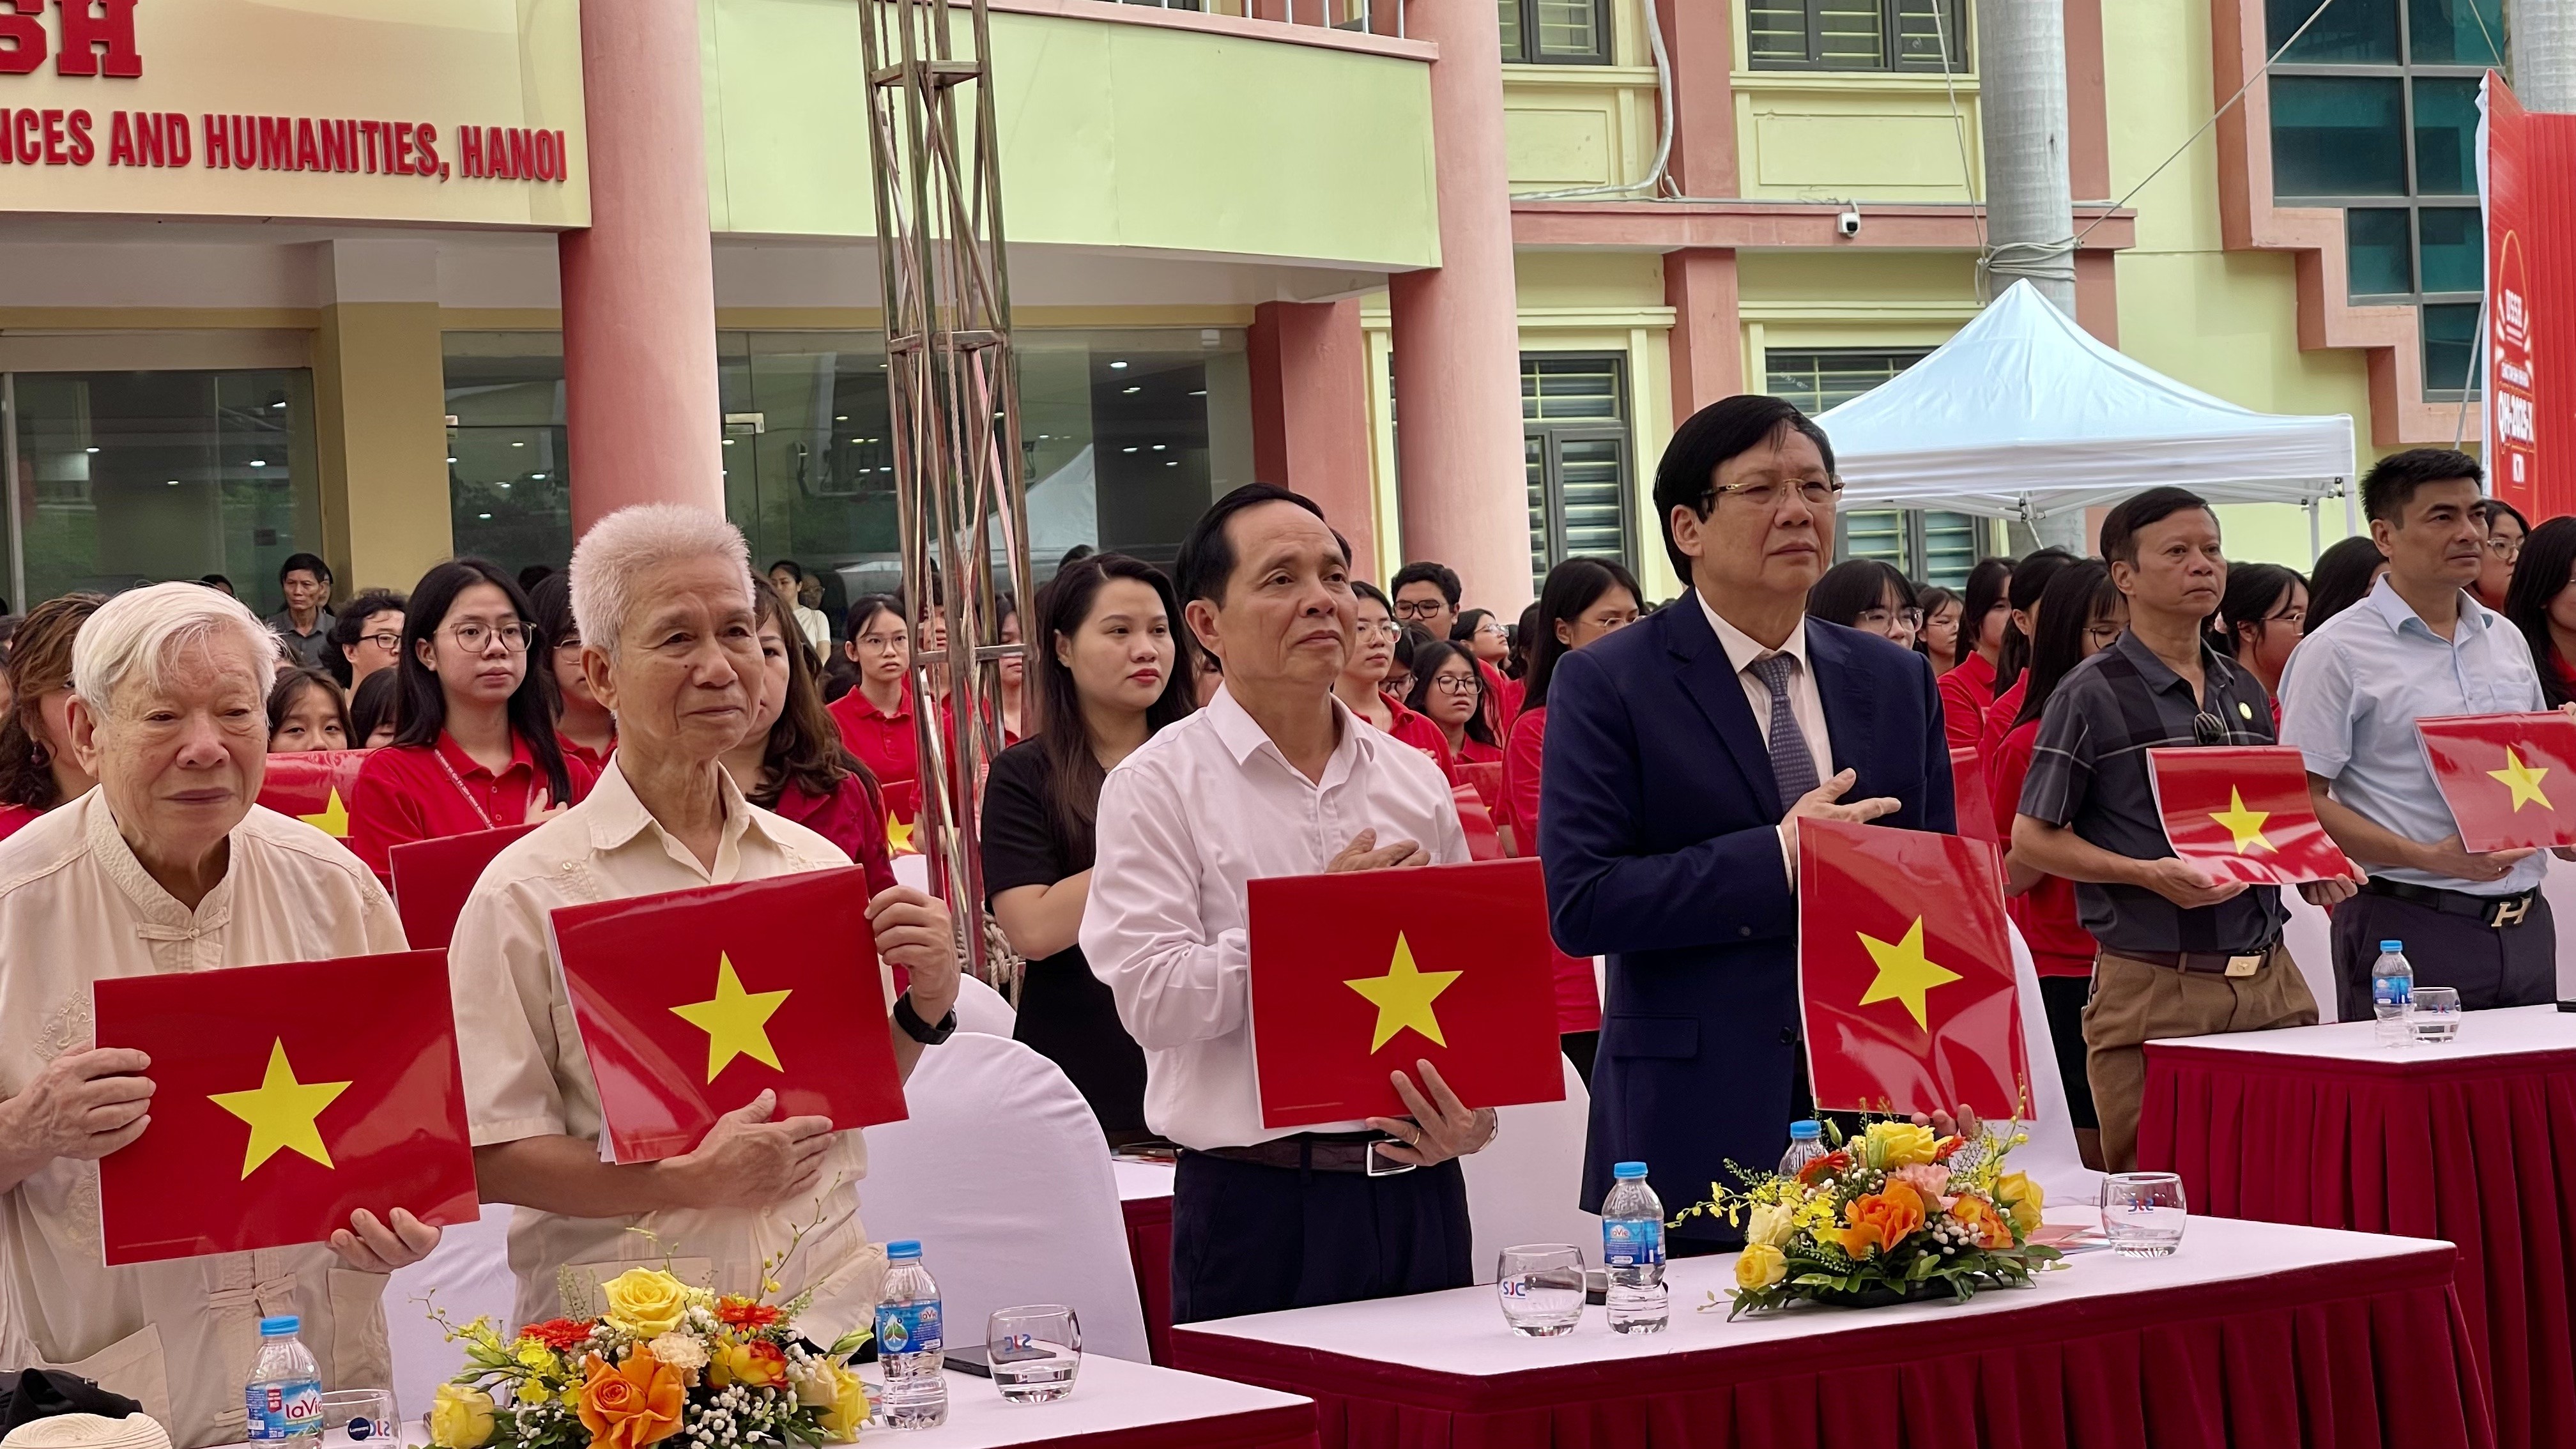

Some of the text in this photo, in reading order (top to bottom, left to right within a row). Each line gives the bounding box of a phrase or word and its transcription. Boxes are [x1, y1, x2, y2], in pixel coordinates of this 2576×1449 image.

[109, 111, 192, 167] AND
[202, 114, 450, 183] HUMANITIES,
[457, 125, 567, 181] HANOI
[1503, 1281, 1526, 1296] SJC
